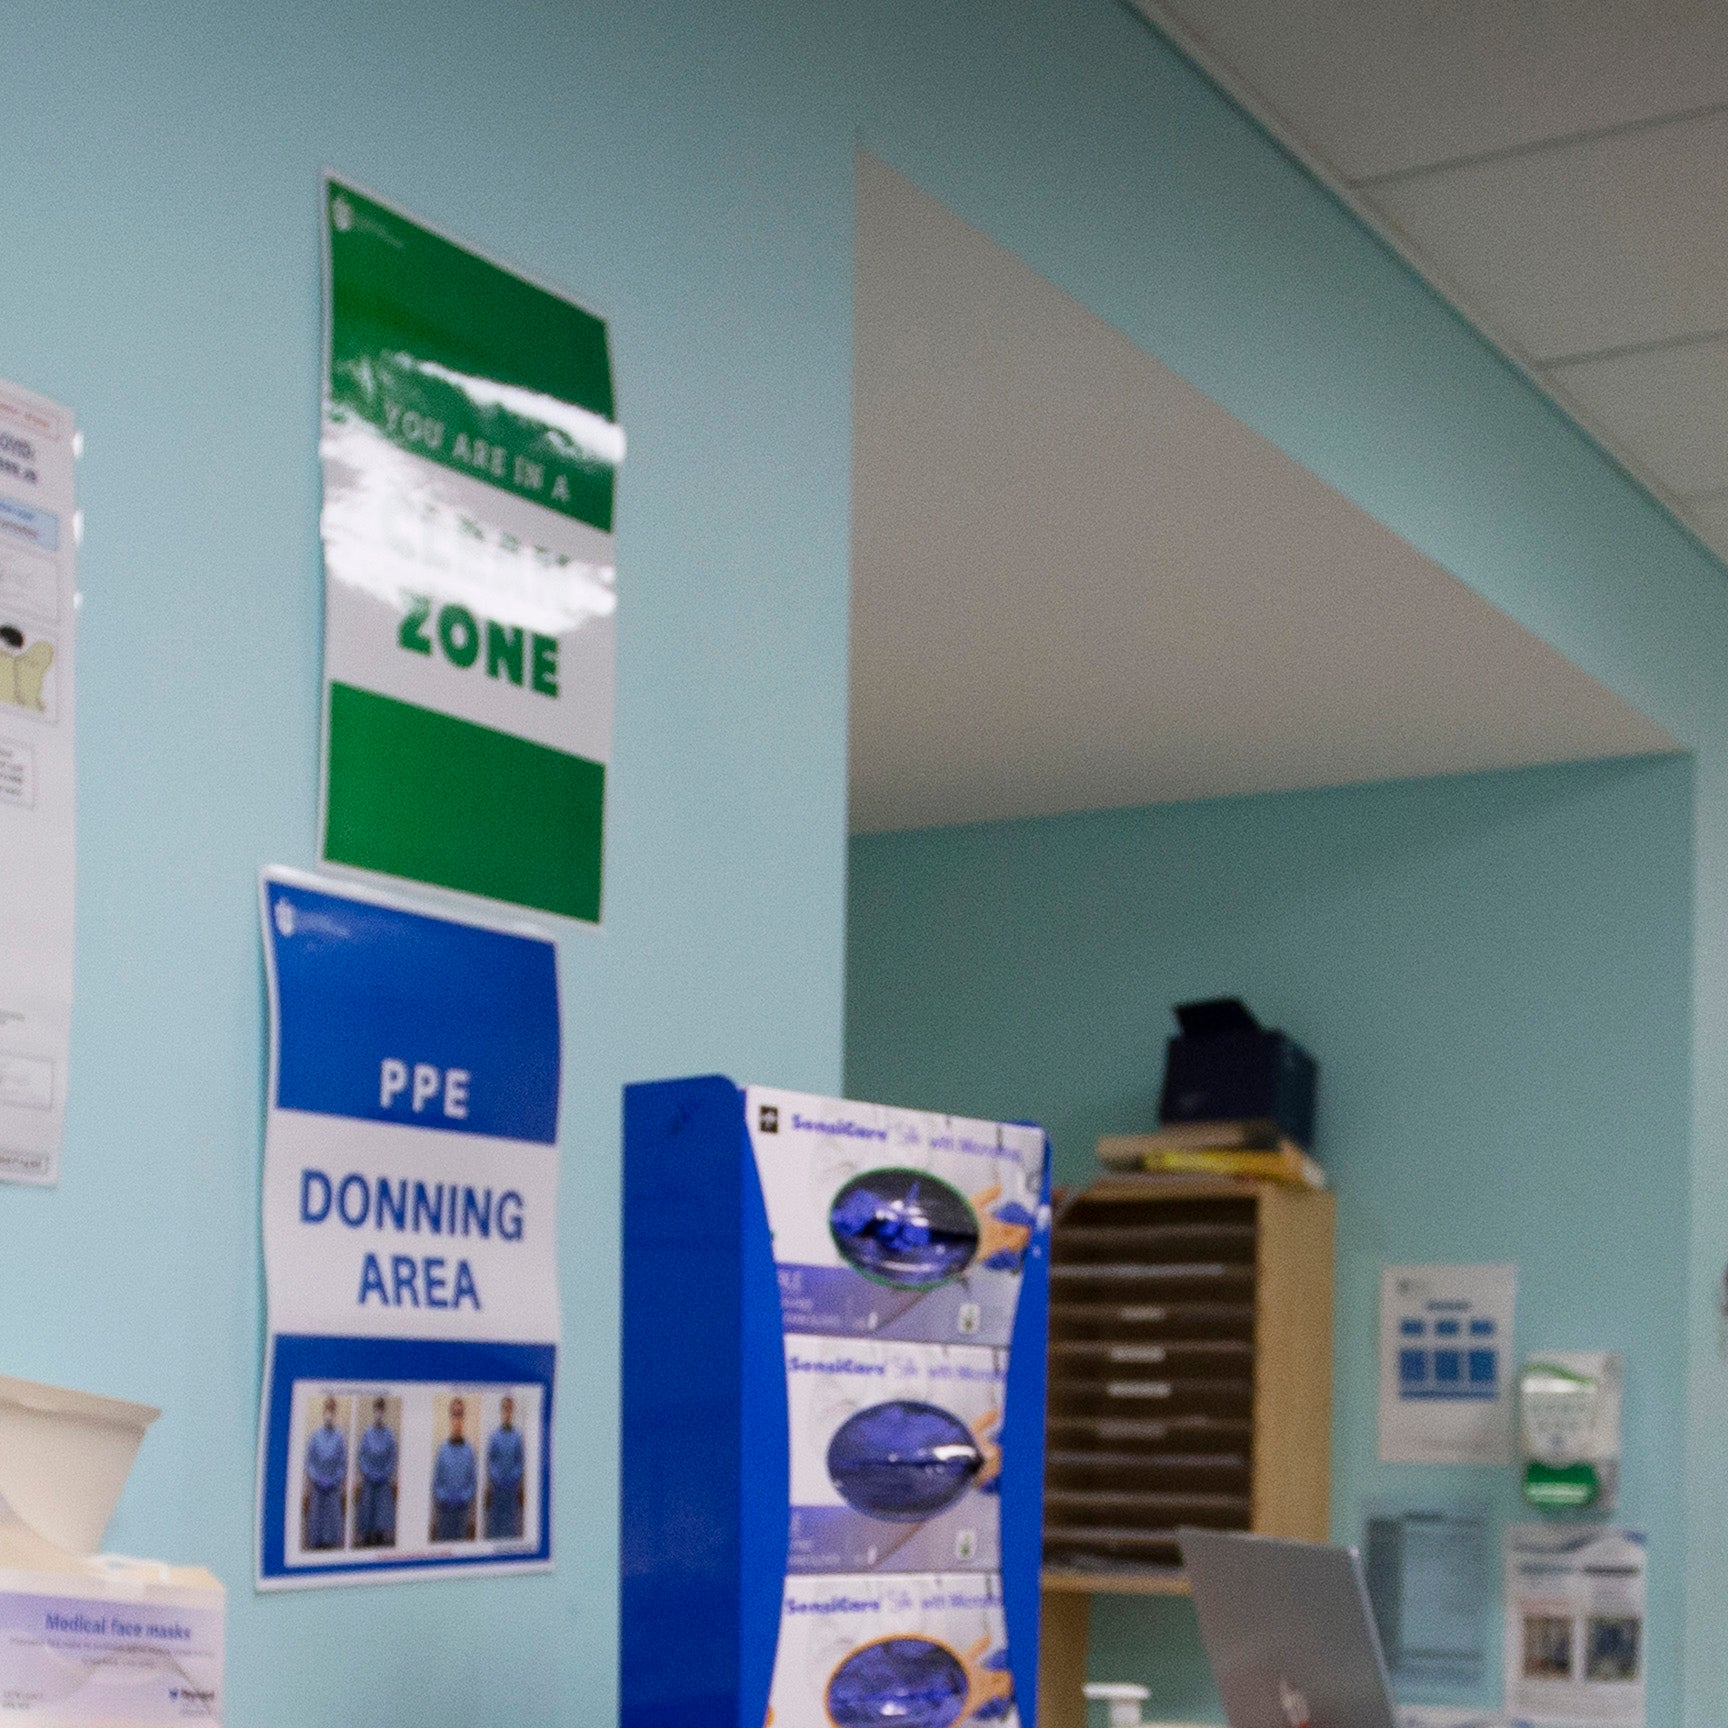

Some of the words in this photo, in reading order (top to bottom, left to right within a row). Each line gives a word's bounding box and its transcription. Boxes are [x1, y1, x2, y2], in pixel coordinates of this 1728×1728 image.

[383, 401, 442, 453] YOU
[453, 431, 507, 478] ARE
[514, 454, 545, 492] IN
[551, 473, 571, 503] A
[398, 589, 560, 699] ZONE
[379, 1057, 471, 1120] PPE
[299, 1168, 526, 1243] DONNING
[356, 1252, 483, 1312] AREA
[45, 1613, 106, 1635] Medical
[110, 1617, 142, 1637] face
[145, 1623, 191, 1641] masks
